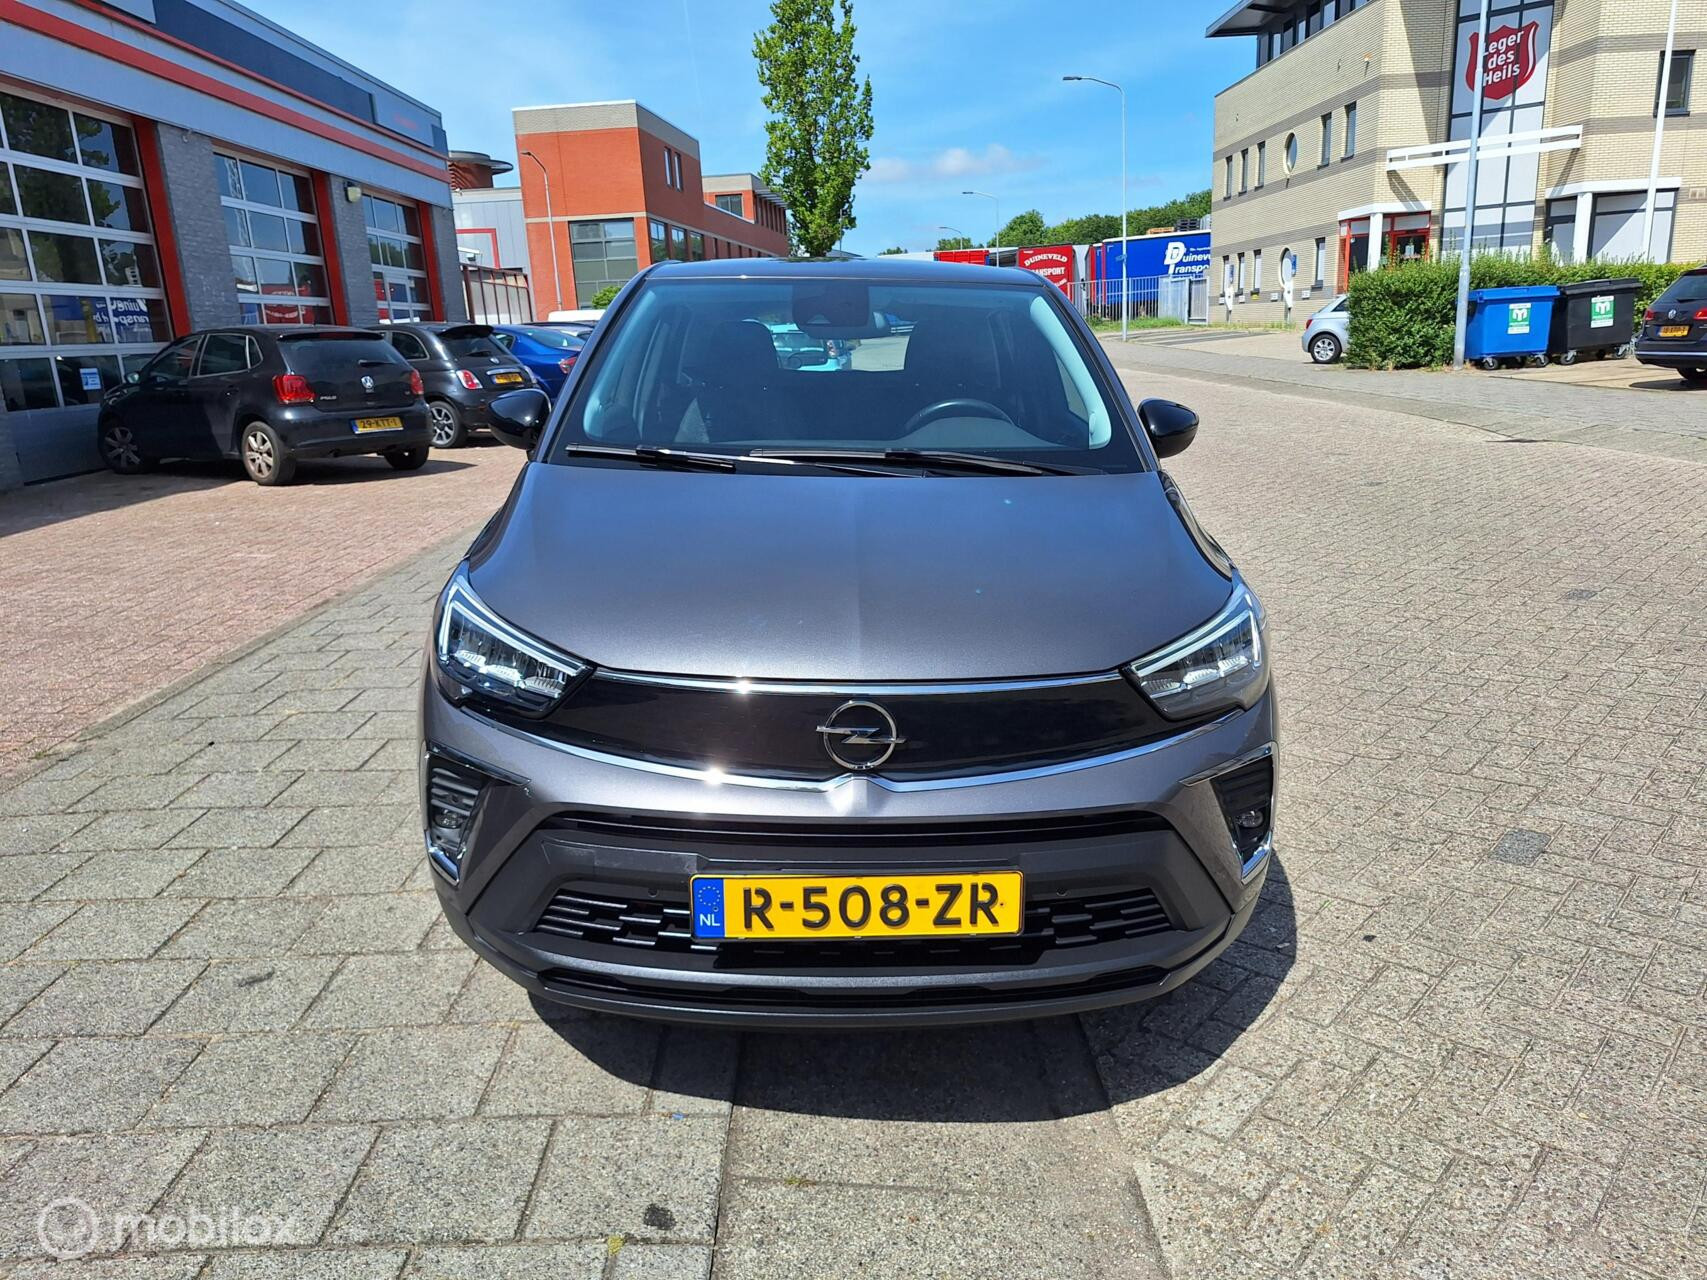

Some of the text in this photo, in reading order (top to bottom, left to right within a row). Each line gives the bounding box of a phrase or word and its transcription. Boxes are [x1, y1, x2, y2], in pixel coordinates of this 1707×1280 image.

[1487, 50, 1515, 69] des
[1482, 63, 1520, 87] Heils
[1024, 253, 1068, 267] DUINEVELD
[1032, 267, 1066, 276] ANSPORT
[743, 882, 999, 931] R-508-ZR
[699, 913, 720, 927] NL
